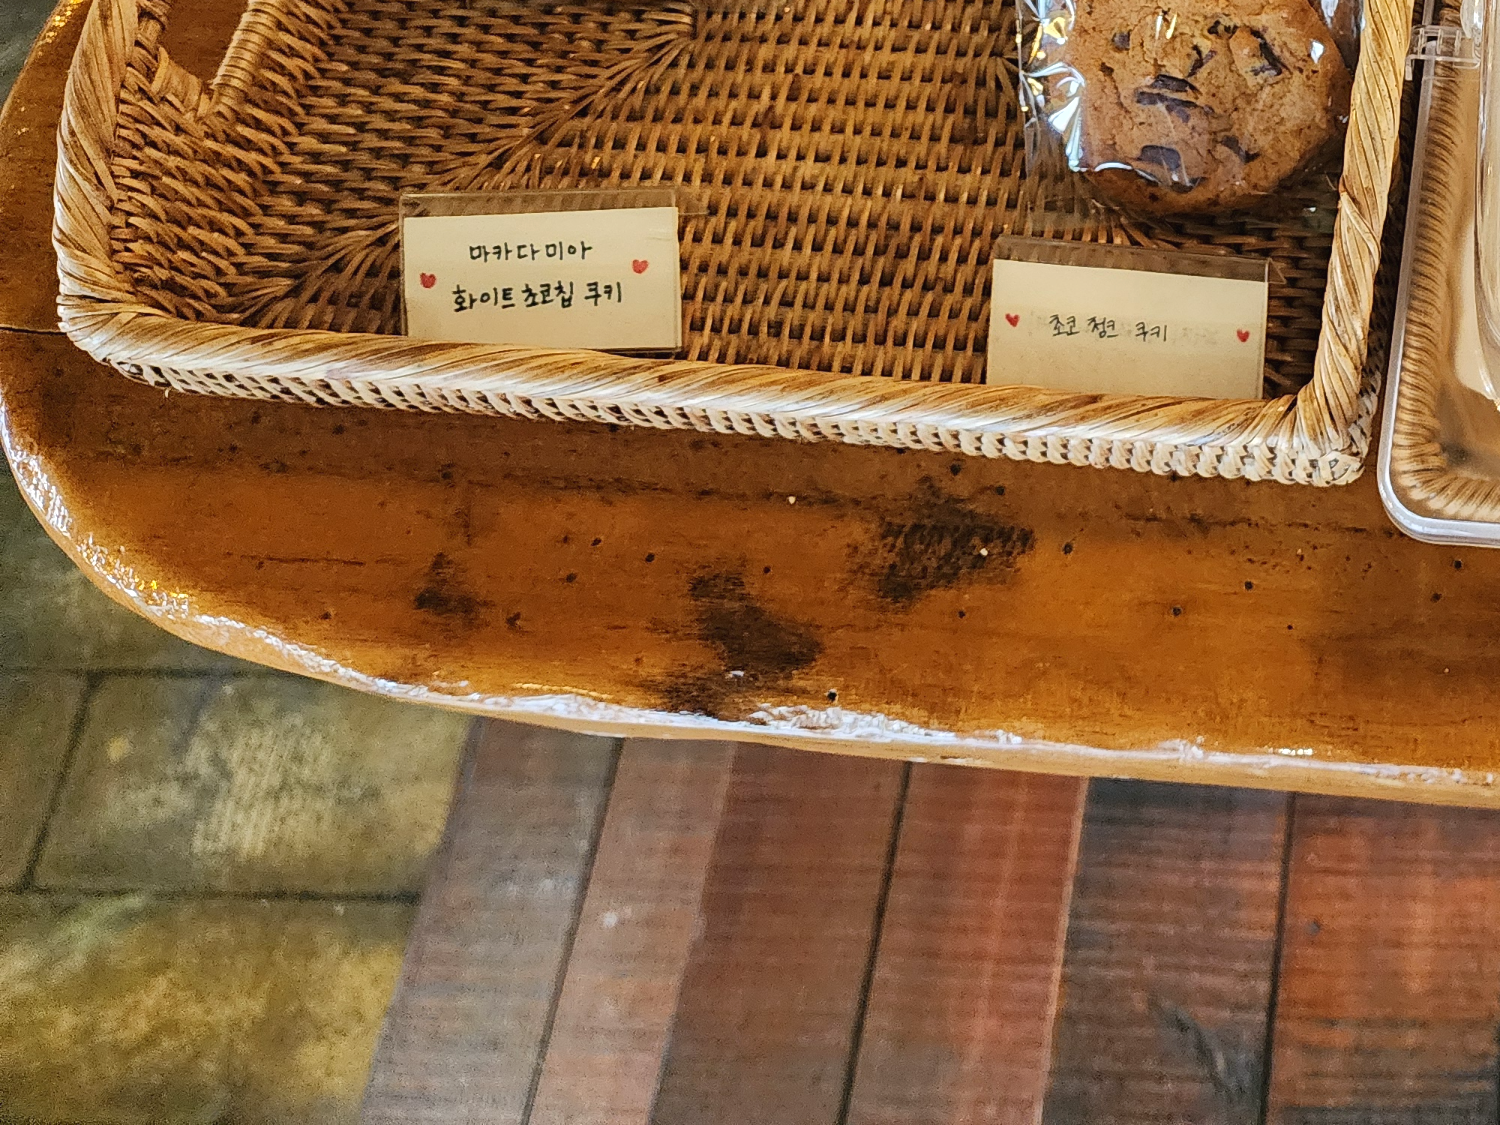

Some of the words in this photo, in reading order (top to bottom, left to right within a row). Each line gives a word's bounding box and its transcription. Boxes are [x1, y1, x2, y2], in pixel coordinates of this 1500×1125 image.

[469, 241, 593, 263] 마카다미아
[451, 283, 516, 313] 화이트
[521, 280, 575, 309] 초코칩
[583, 280, 624, 308] 쿠키
[1135, 321, 1168, 342] 쿠키
